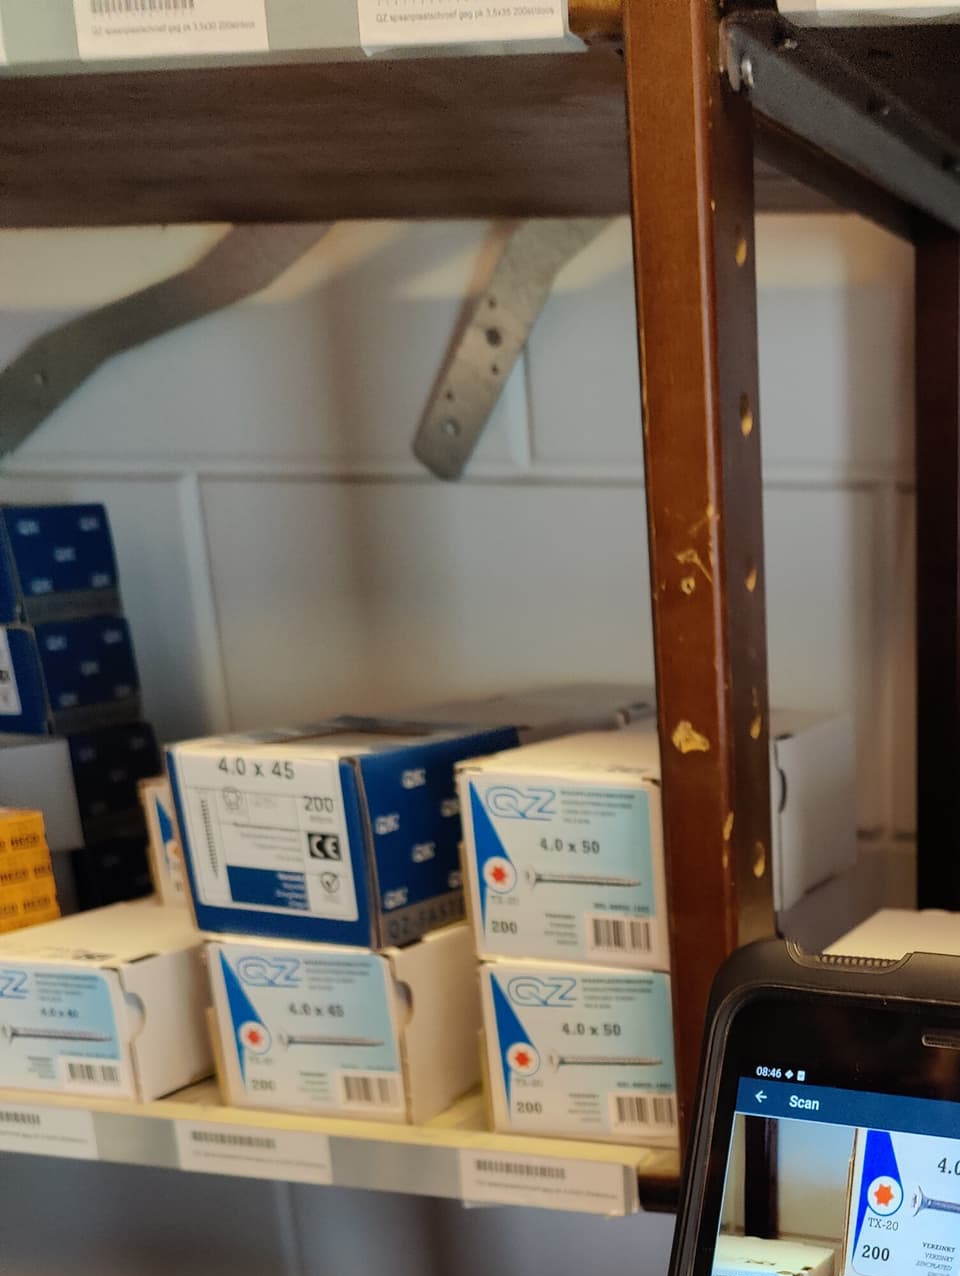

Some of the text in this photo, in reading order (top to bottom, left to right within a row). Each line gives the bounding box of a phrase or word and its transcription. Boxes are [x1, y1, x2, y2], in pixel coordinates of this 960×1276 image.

[218, 757, 296, 780] 4.0 x 45
[304, 796, 335, 813] 200
[485, 785, 557, 822] QZ
[492, 920, 518, 935] 200
[237, 956, 302, 988] QZ
[507, 976, 577, 1008] QZ
[562, 1022, 585, 1036] 4.0
[603, 1023, 622, 1037] 50
[756, 1066, 782, 1079] 08:46
[517, 1101, 543, 1115] 200
[788, 1095, 820, 1111] Scan
[868, 1217, 899, 1231] TX-20
[862, 1244, 890, 1262] 200
